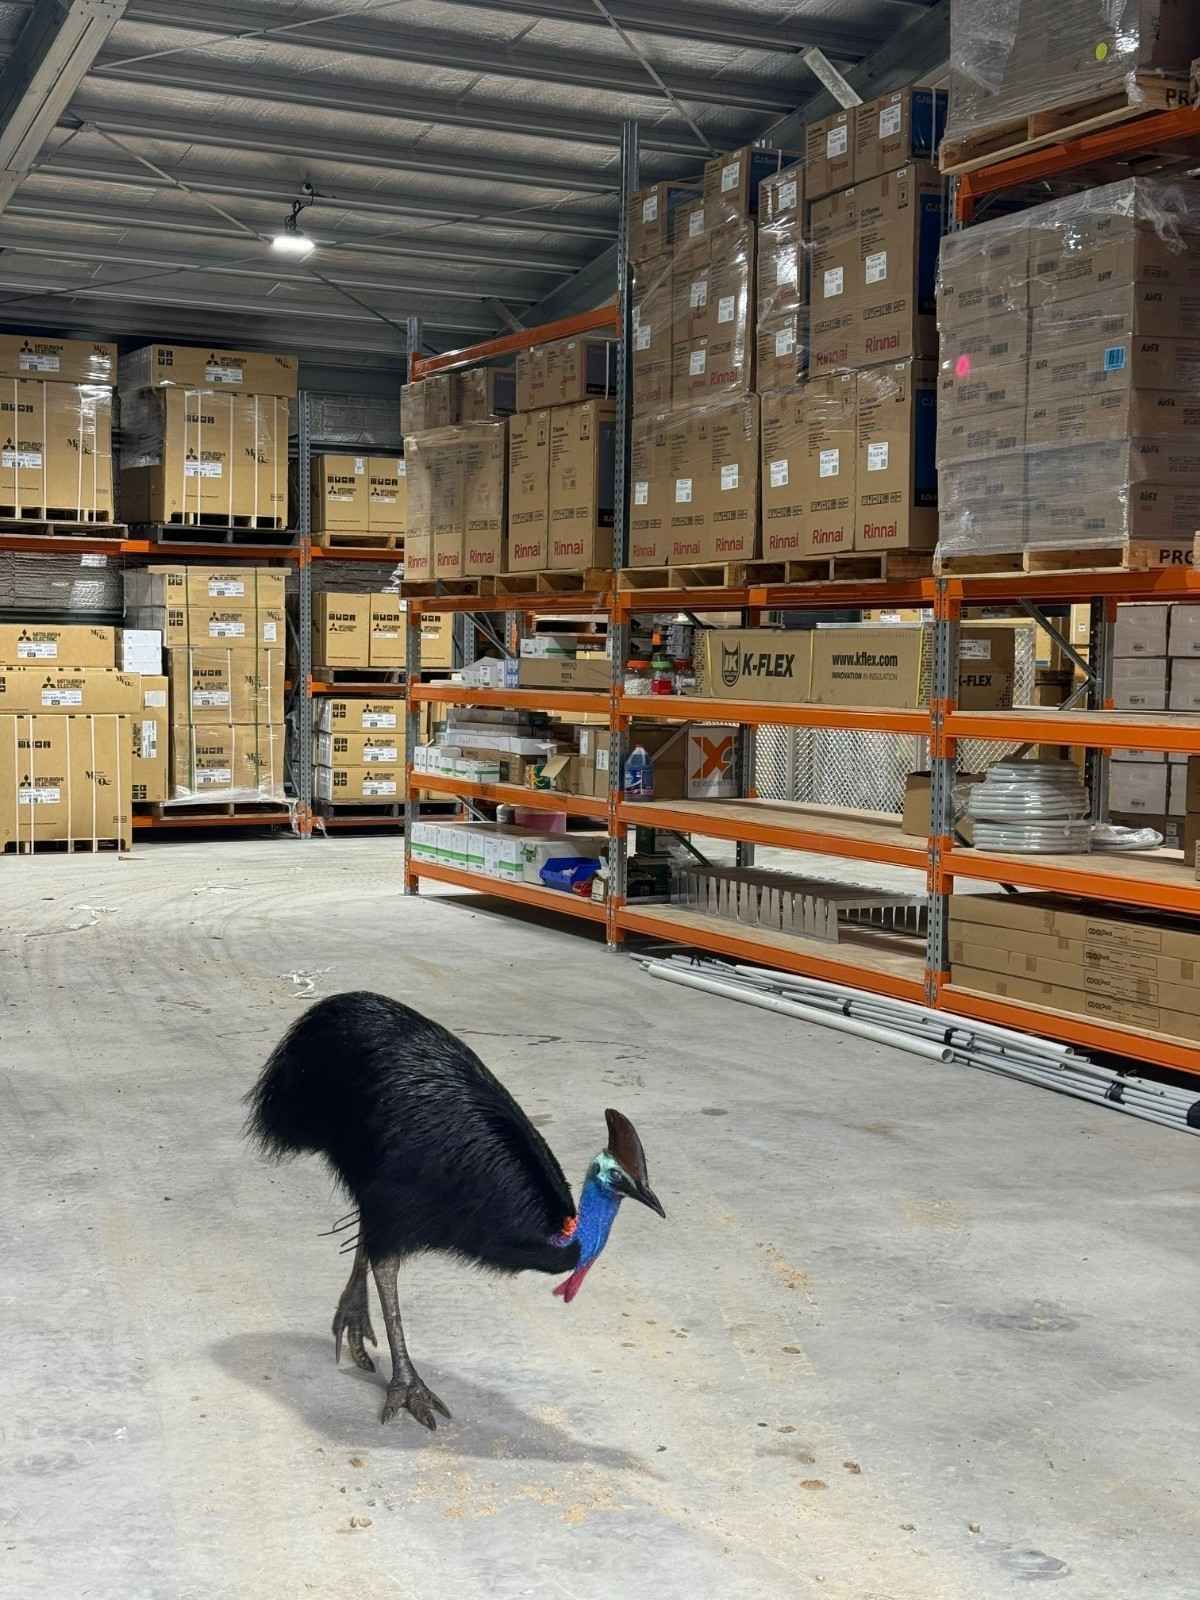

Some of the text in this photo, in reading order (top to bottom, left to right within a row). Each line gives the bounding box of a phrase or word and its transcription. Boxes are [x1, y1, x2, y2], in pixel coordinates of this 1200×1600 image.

[812, 525, 844, 544] Rinnai
[863, 521, 898, 539] Rinnai
[553, 539, 584, 556] Rinnai
[673, 540, 701, 556] Rinnai
[715, 535, 744, 553] Rinnai
[769, 531, 799, 550] Rinnai
[437, 551, 459, 567] Rinnai
[469, 549, 495, 564] Rinnai
[514, 541, 541, 560] Rinnai
[741, 653, 796, 678] K-FLEX
[831, 651, 899, 667] www.kflex.com
